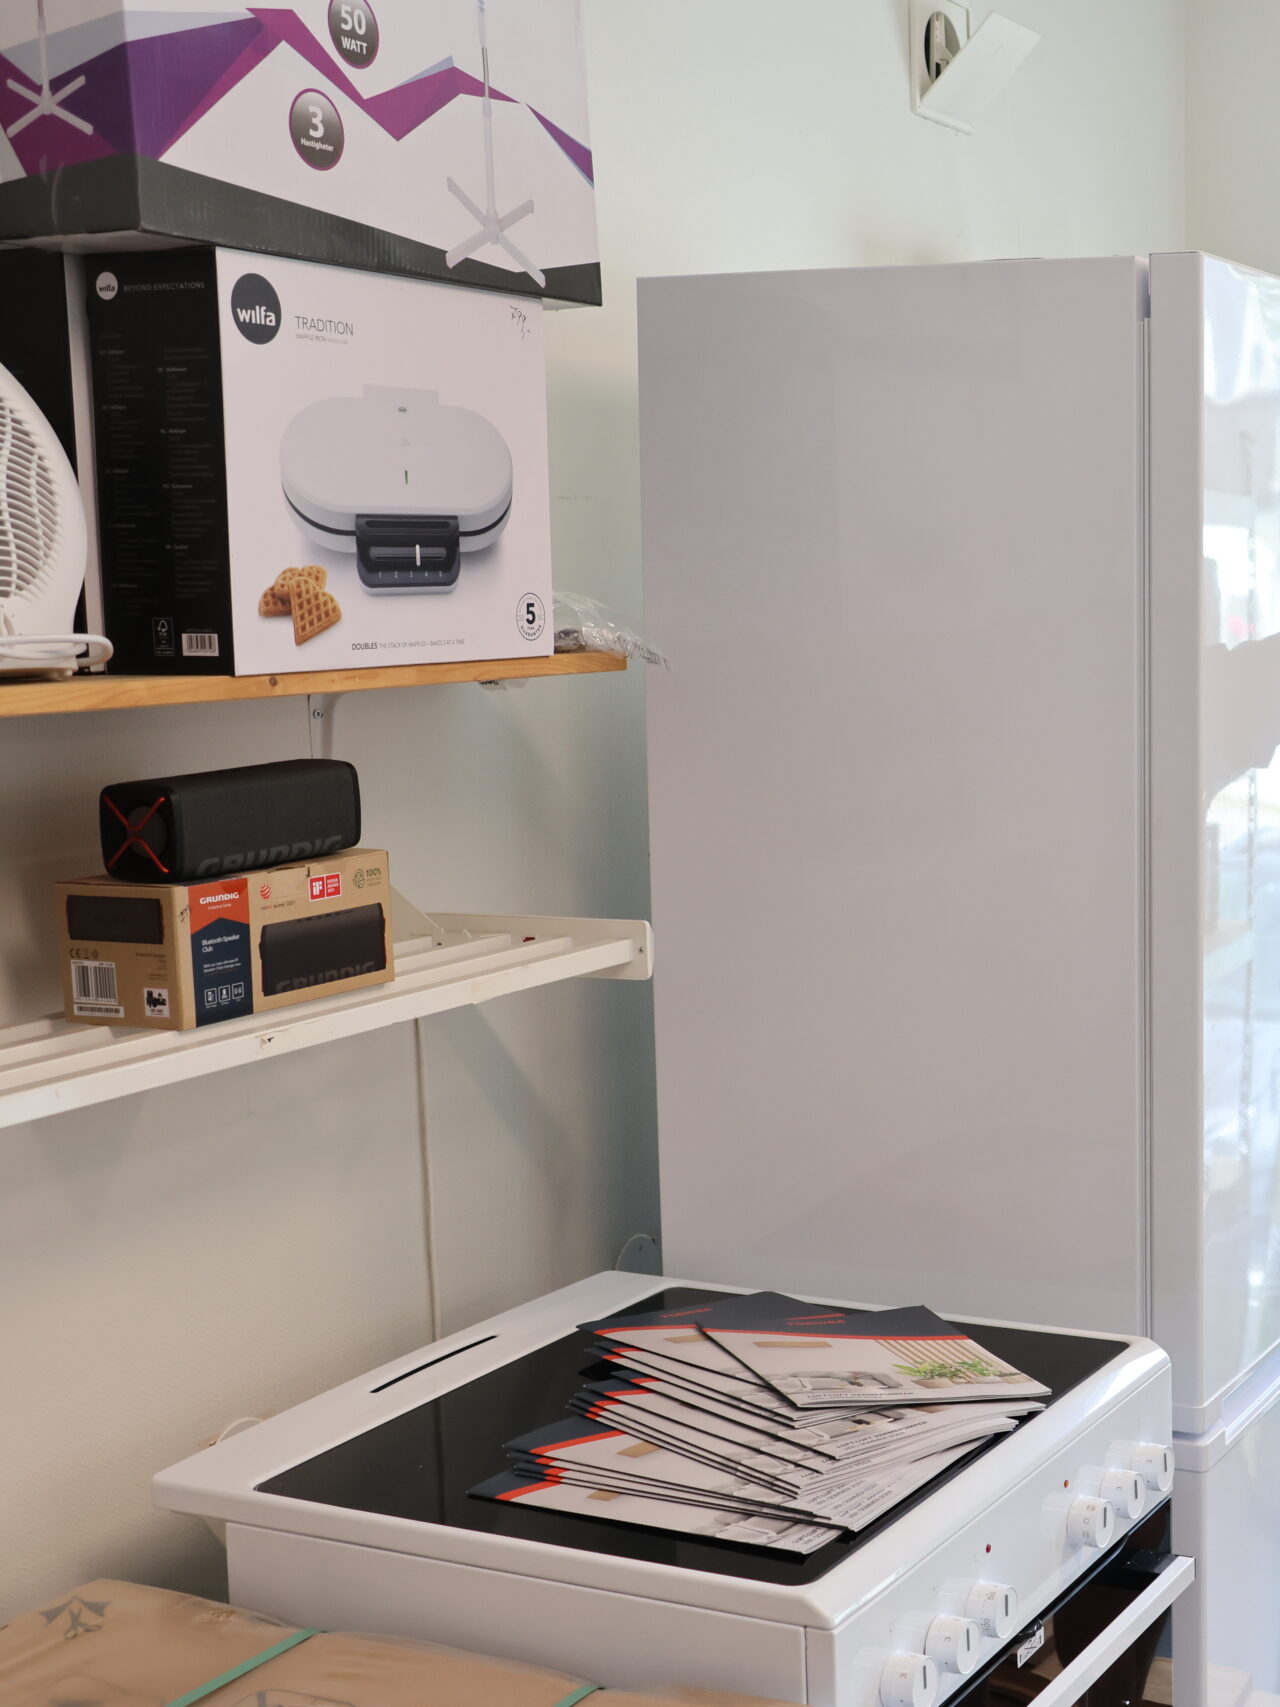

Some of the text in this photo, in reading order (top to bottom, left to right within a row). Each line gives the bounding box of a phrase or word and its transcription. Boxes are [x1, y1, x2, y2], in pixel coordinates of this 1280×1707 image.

[340, 8, 367, 34] 50
[341, 36, 368, 55] WATT
[308, 106, 325, 138] 3
[124, 281, 205, 292] BEYOND EXPECTATIONS
[237, 305, 276, 327] wilfa
[295, 315, 354, 336] TRADITION
[525, 602, 536, 625] 5
[352, 642, 378, 651] DOUBLES
[199, 891, 240, 905] GRUNDIG
[202, 935, 223, 946] Bluetooth
